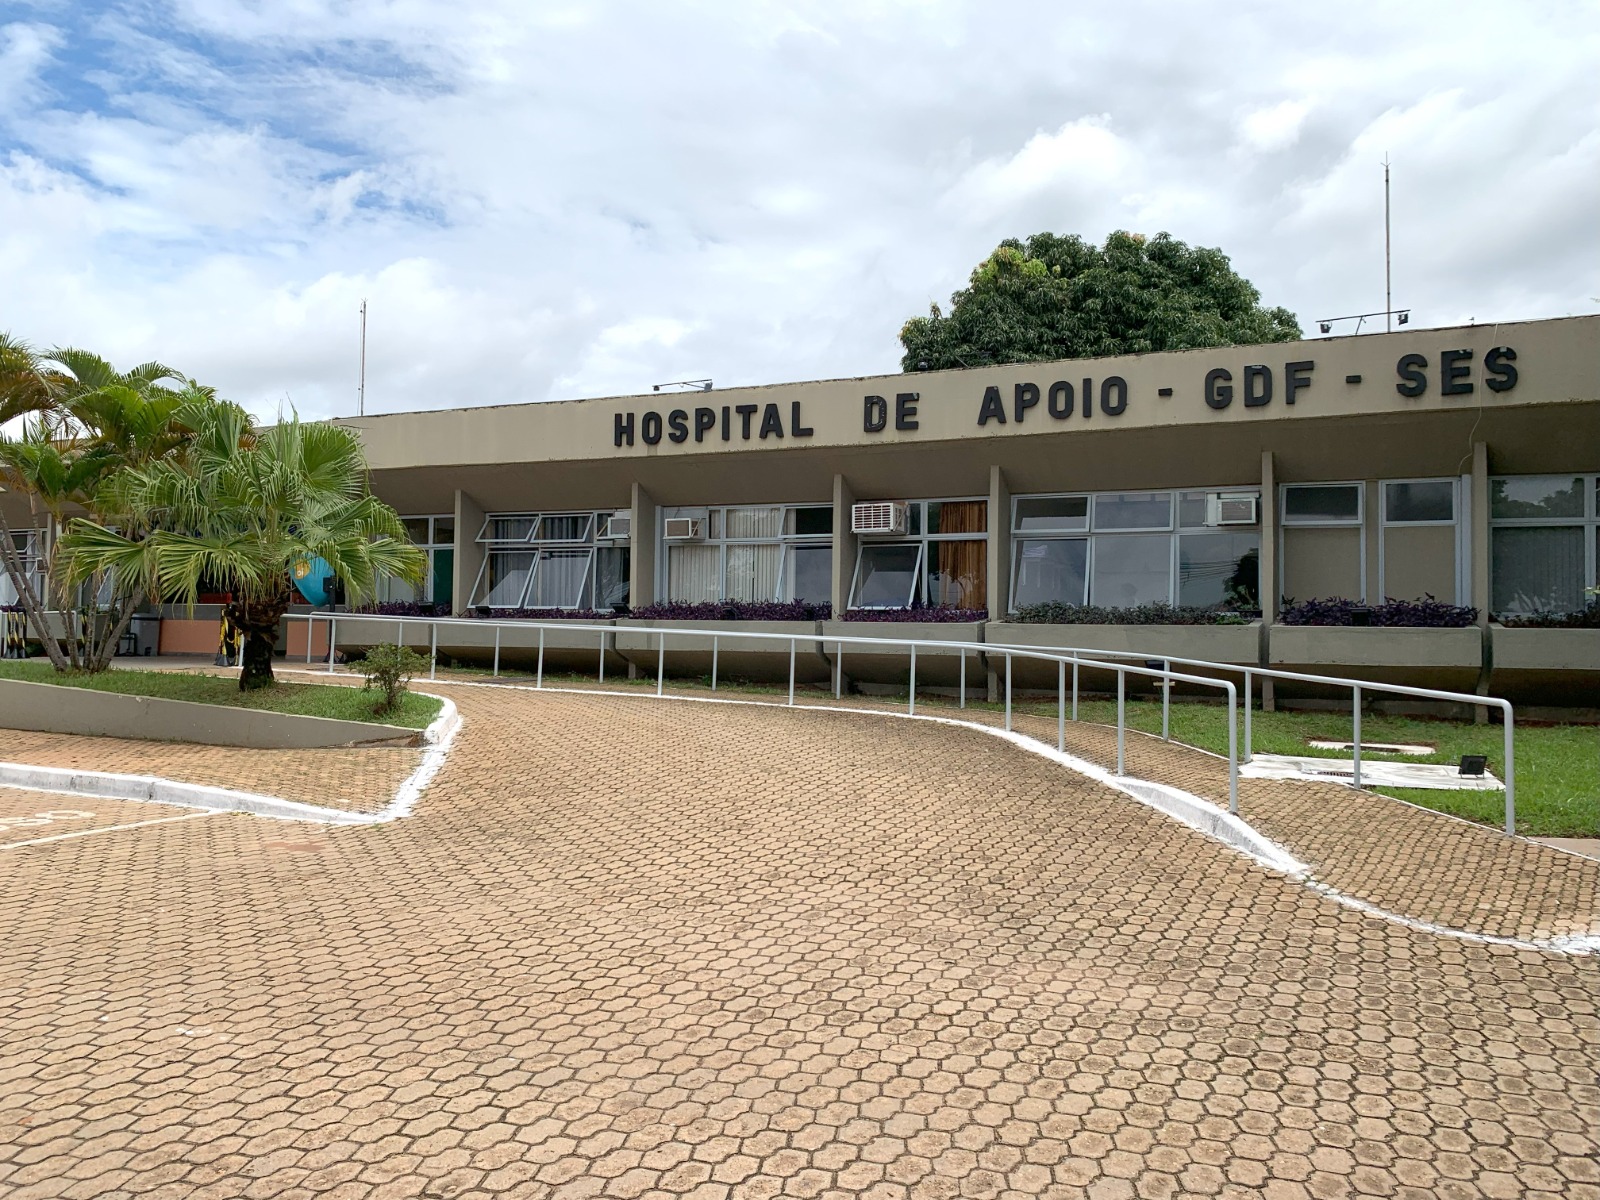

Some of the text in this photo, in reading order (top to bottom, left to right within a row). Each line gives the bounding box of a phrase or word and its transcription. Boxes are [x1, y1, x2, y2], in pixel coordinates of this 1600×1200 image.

[614, 401, 815, 448] HOSPITAL
[863, 393, 921, 434] DE
[977, 376, 1129, 427] APOIO
[1205, 360, 1316, 410] GDF
[1396, 346, 1521, 398] SES
